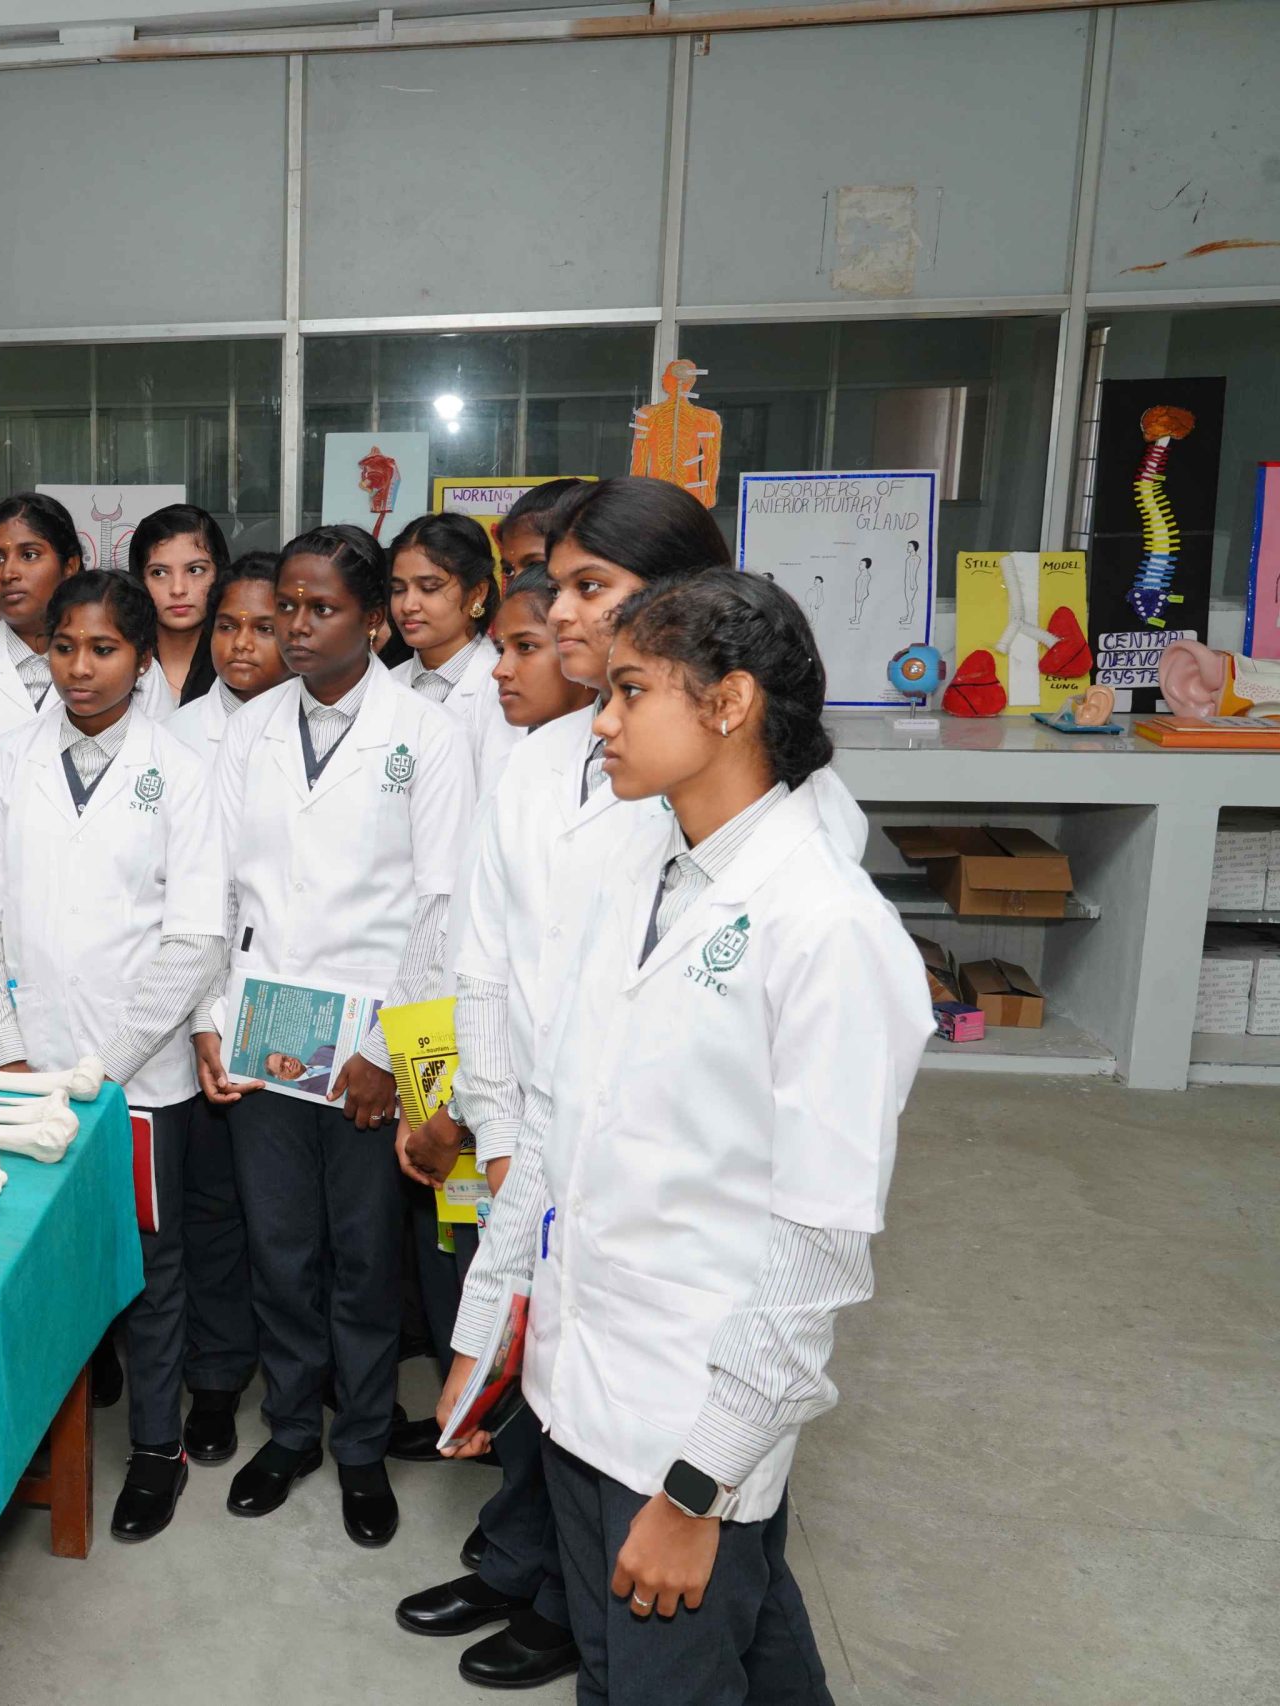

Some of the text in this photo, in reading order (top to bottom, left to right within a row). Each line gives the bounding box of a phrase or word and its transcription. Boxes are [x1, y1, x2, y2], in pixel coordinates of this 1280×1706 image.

[452, 488, 513, 502] WORKING
[762, 480, 906, 499] DISORDERS OF
[814, 496, 883, 514] PITUITARY
[856, 512, 920, 531] GLAND
[965, 557, 1081, 570] STILL MODEL
[1100, 650, 1163, 668] NERVO
[130, 800, 159, 815] STPC
[683, 964, 729, 997] STPC
[417, 1036, 431, 1049] go
